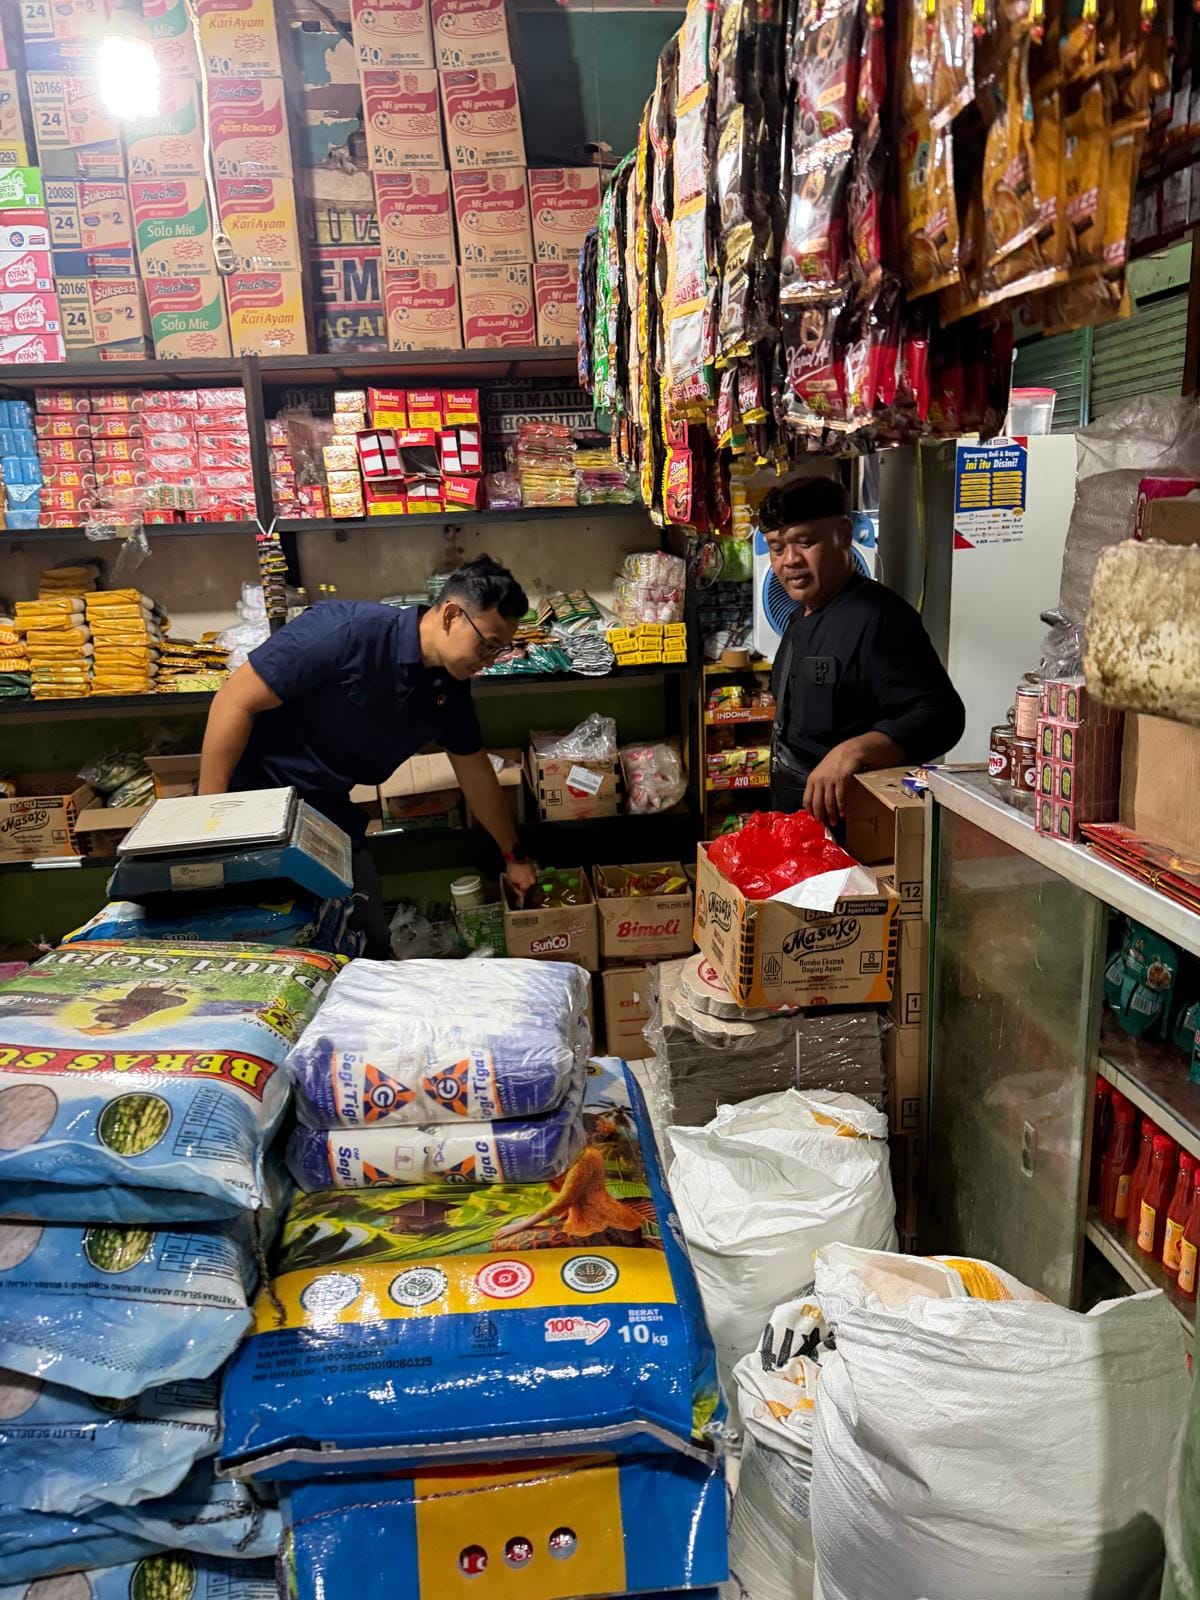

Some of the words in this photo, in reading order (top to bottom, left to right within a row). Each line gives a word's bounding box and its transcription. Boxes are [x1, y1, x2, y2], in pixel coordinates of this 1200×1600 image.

[25, 4, 46, 18] 24
[209, 17, 232, 28] Kari
[233, 17, 264, 30] Ayam
[154, 24, 174, 36] Mie
[33, 81, 61, 94] 20166
[377, 101, 393, 109] Mi
[458, 100, 473, 109] Mi
[41, 112, 62, 126] 24
[218, 124, 241, 134] Ayam
[242, 124, 276, 134] Bawang
[48, 187, 74, 199] 20088
[391, 200, 405, 210] Mi
[467, 200, 482, 210] Mi
[543, 198, 558, 207] Mi
[54, 216, 74, 229] 24
[113, 212, 121, 224] 2
[148, 226, 173, 237] Soto
[175, 224, 196, 236] Mie
[232, 220, 255, 229] Kari
[257, 219, 286, 232] Ayam
[8, 270, 29, 280] AYAM
[59, 283, 86, 294] 20166
[155, 284, 196, 295] Indomie
[234, 280, 277, 290] Indomie
[401, 297, 412, 305] Mi
[17, 311, 38, 320] AYAM
[125, 307, 134, 318] 2
[67, 313, 87, 325] 24
[161, 319, 187, 331] Soto
[189, 318, 209, 330] Mie
[241, 315, 263, 324] Kari
[263, 314, 294, 326] Ayam
[965, 460, 977, 470] ini
[979, 459, 991, 469] itu
[993, 458, 1018, 468] Disini!
[717, 711, 751, 719] INDOMIE
[734, 776, 748, 786] AYO
[551, 791, 557, 799] 6
[11, 800, 37, 812] BARU
[1, 810, 47, 832] Masako
[904, 886, 919, 898] 12
[617, 919, 680, 938] Bimoli
[783, 917, 857, 953] Masako
[532, 936, 567, 951] SunCo
[869, 952, 875, 962] 8
[802, 966, 823, 974] Daging
[66, 1050, 264, 1087] BERAS
[337, 1053, 357, 1091] Segi
[475, 1141, 488, 1152] G
[337, 1146, 354, 1182] Segi
[174, 1289, 203, 1300] SELALU
[628, 1315, 663, 1323] BERSIH
[629, 1309, 659, 1317] BERAT
[549, 1317, 584, 1333] 100%
[618, 1324, 649, 1344] 10
[652, 1332, 668, 1346] kg
